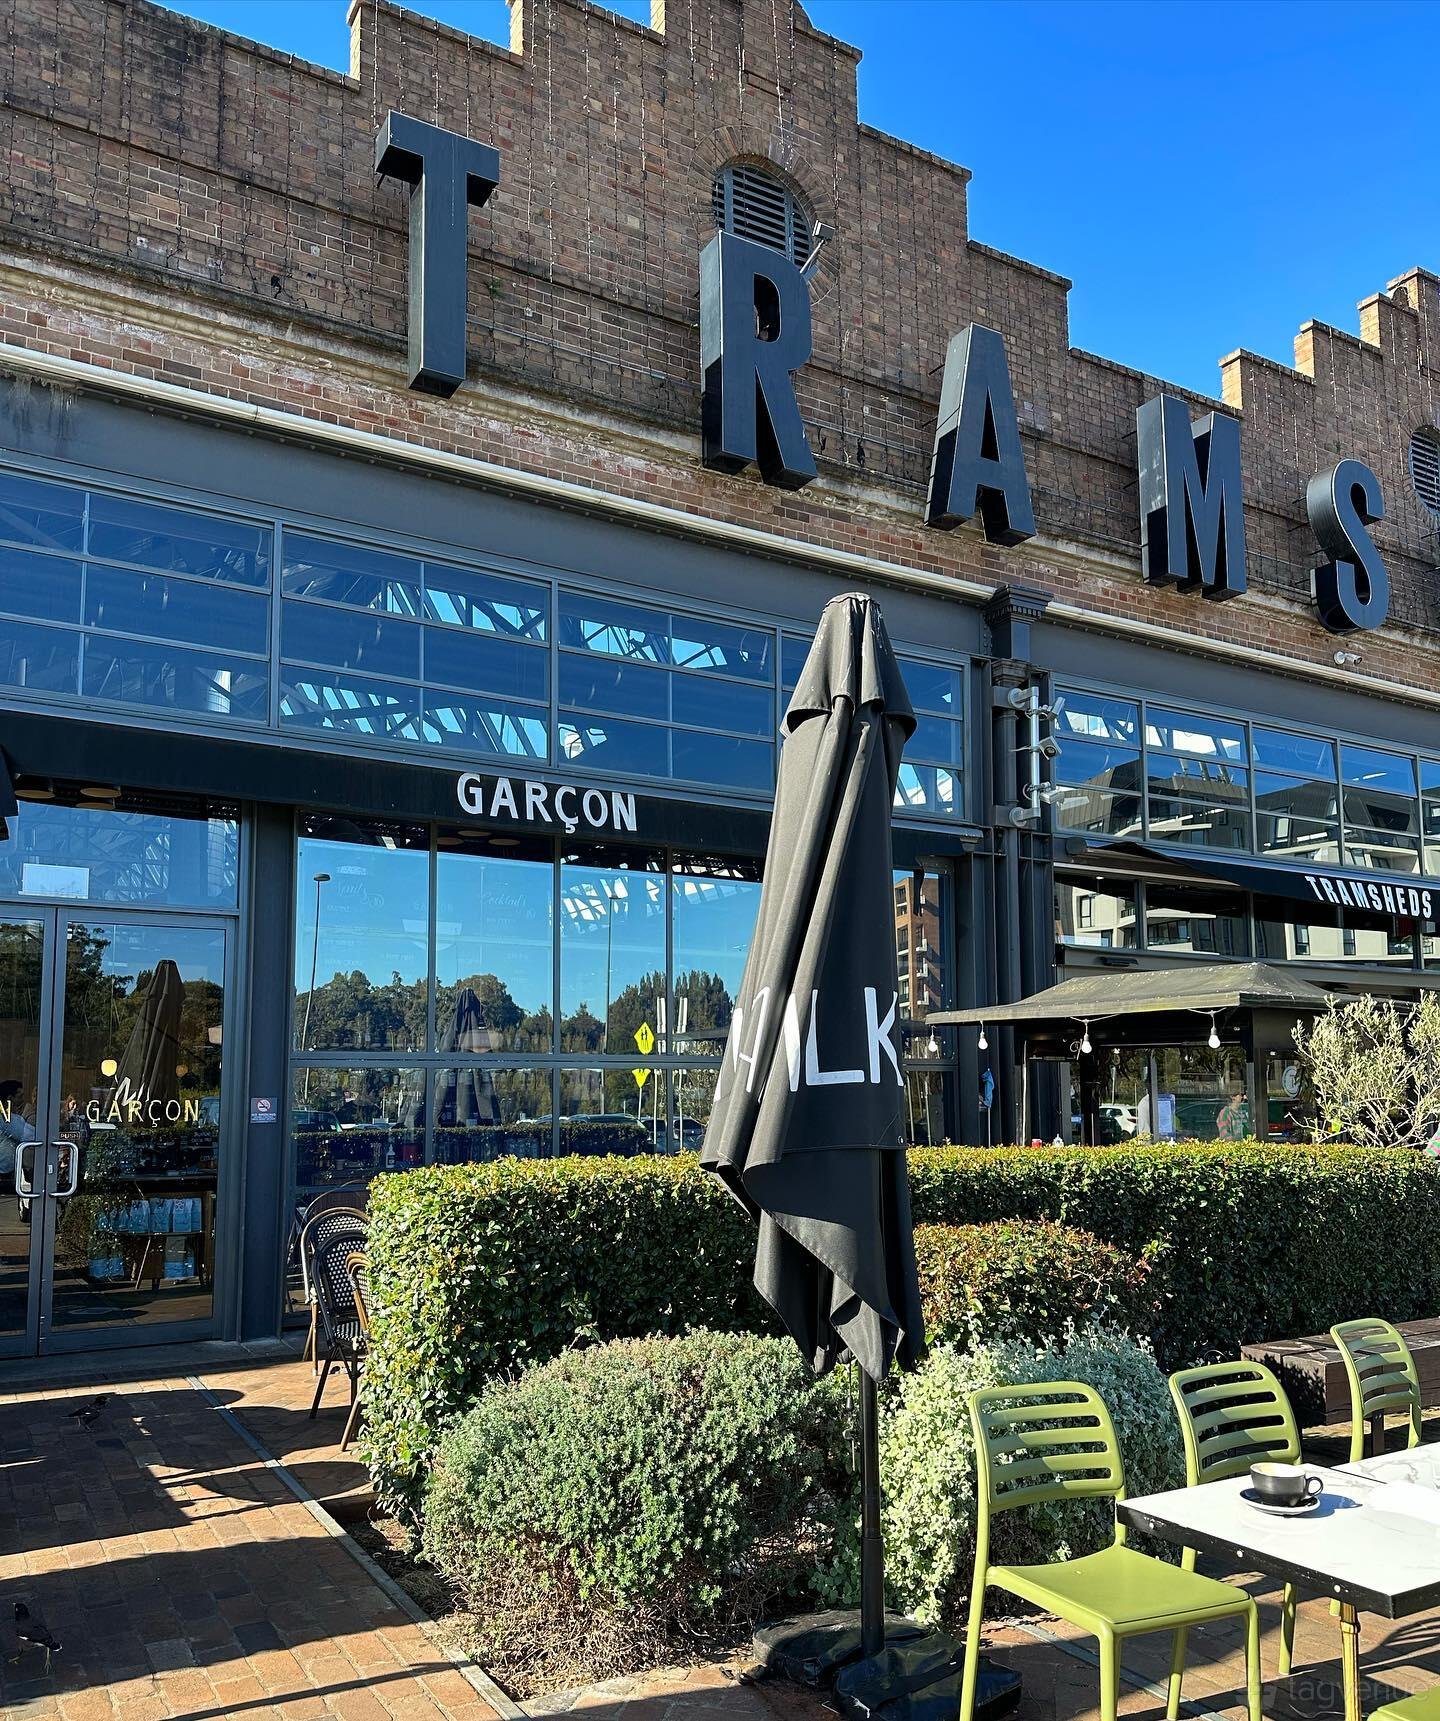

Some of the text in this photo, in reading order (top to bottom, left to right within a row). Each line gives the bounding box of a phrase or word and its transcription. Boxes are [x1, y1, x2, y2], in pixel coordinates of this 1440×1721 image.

[375, 109, 1390, 635] TRAMS
[457, 772, 638, 834] GARÇON
[1304, 875, 1432, 919] TRAMSHEDS
[86, 1099, 199, 1128] GARÇON
